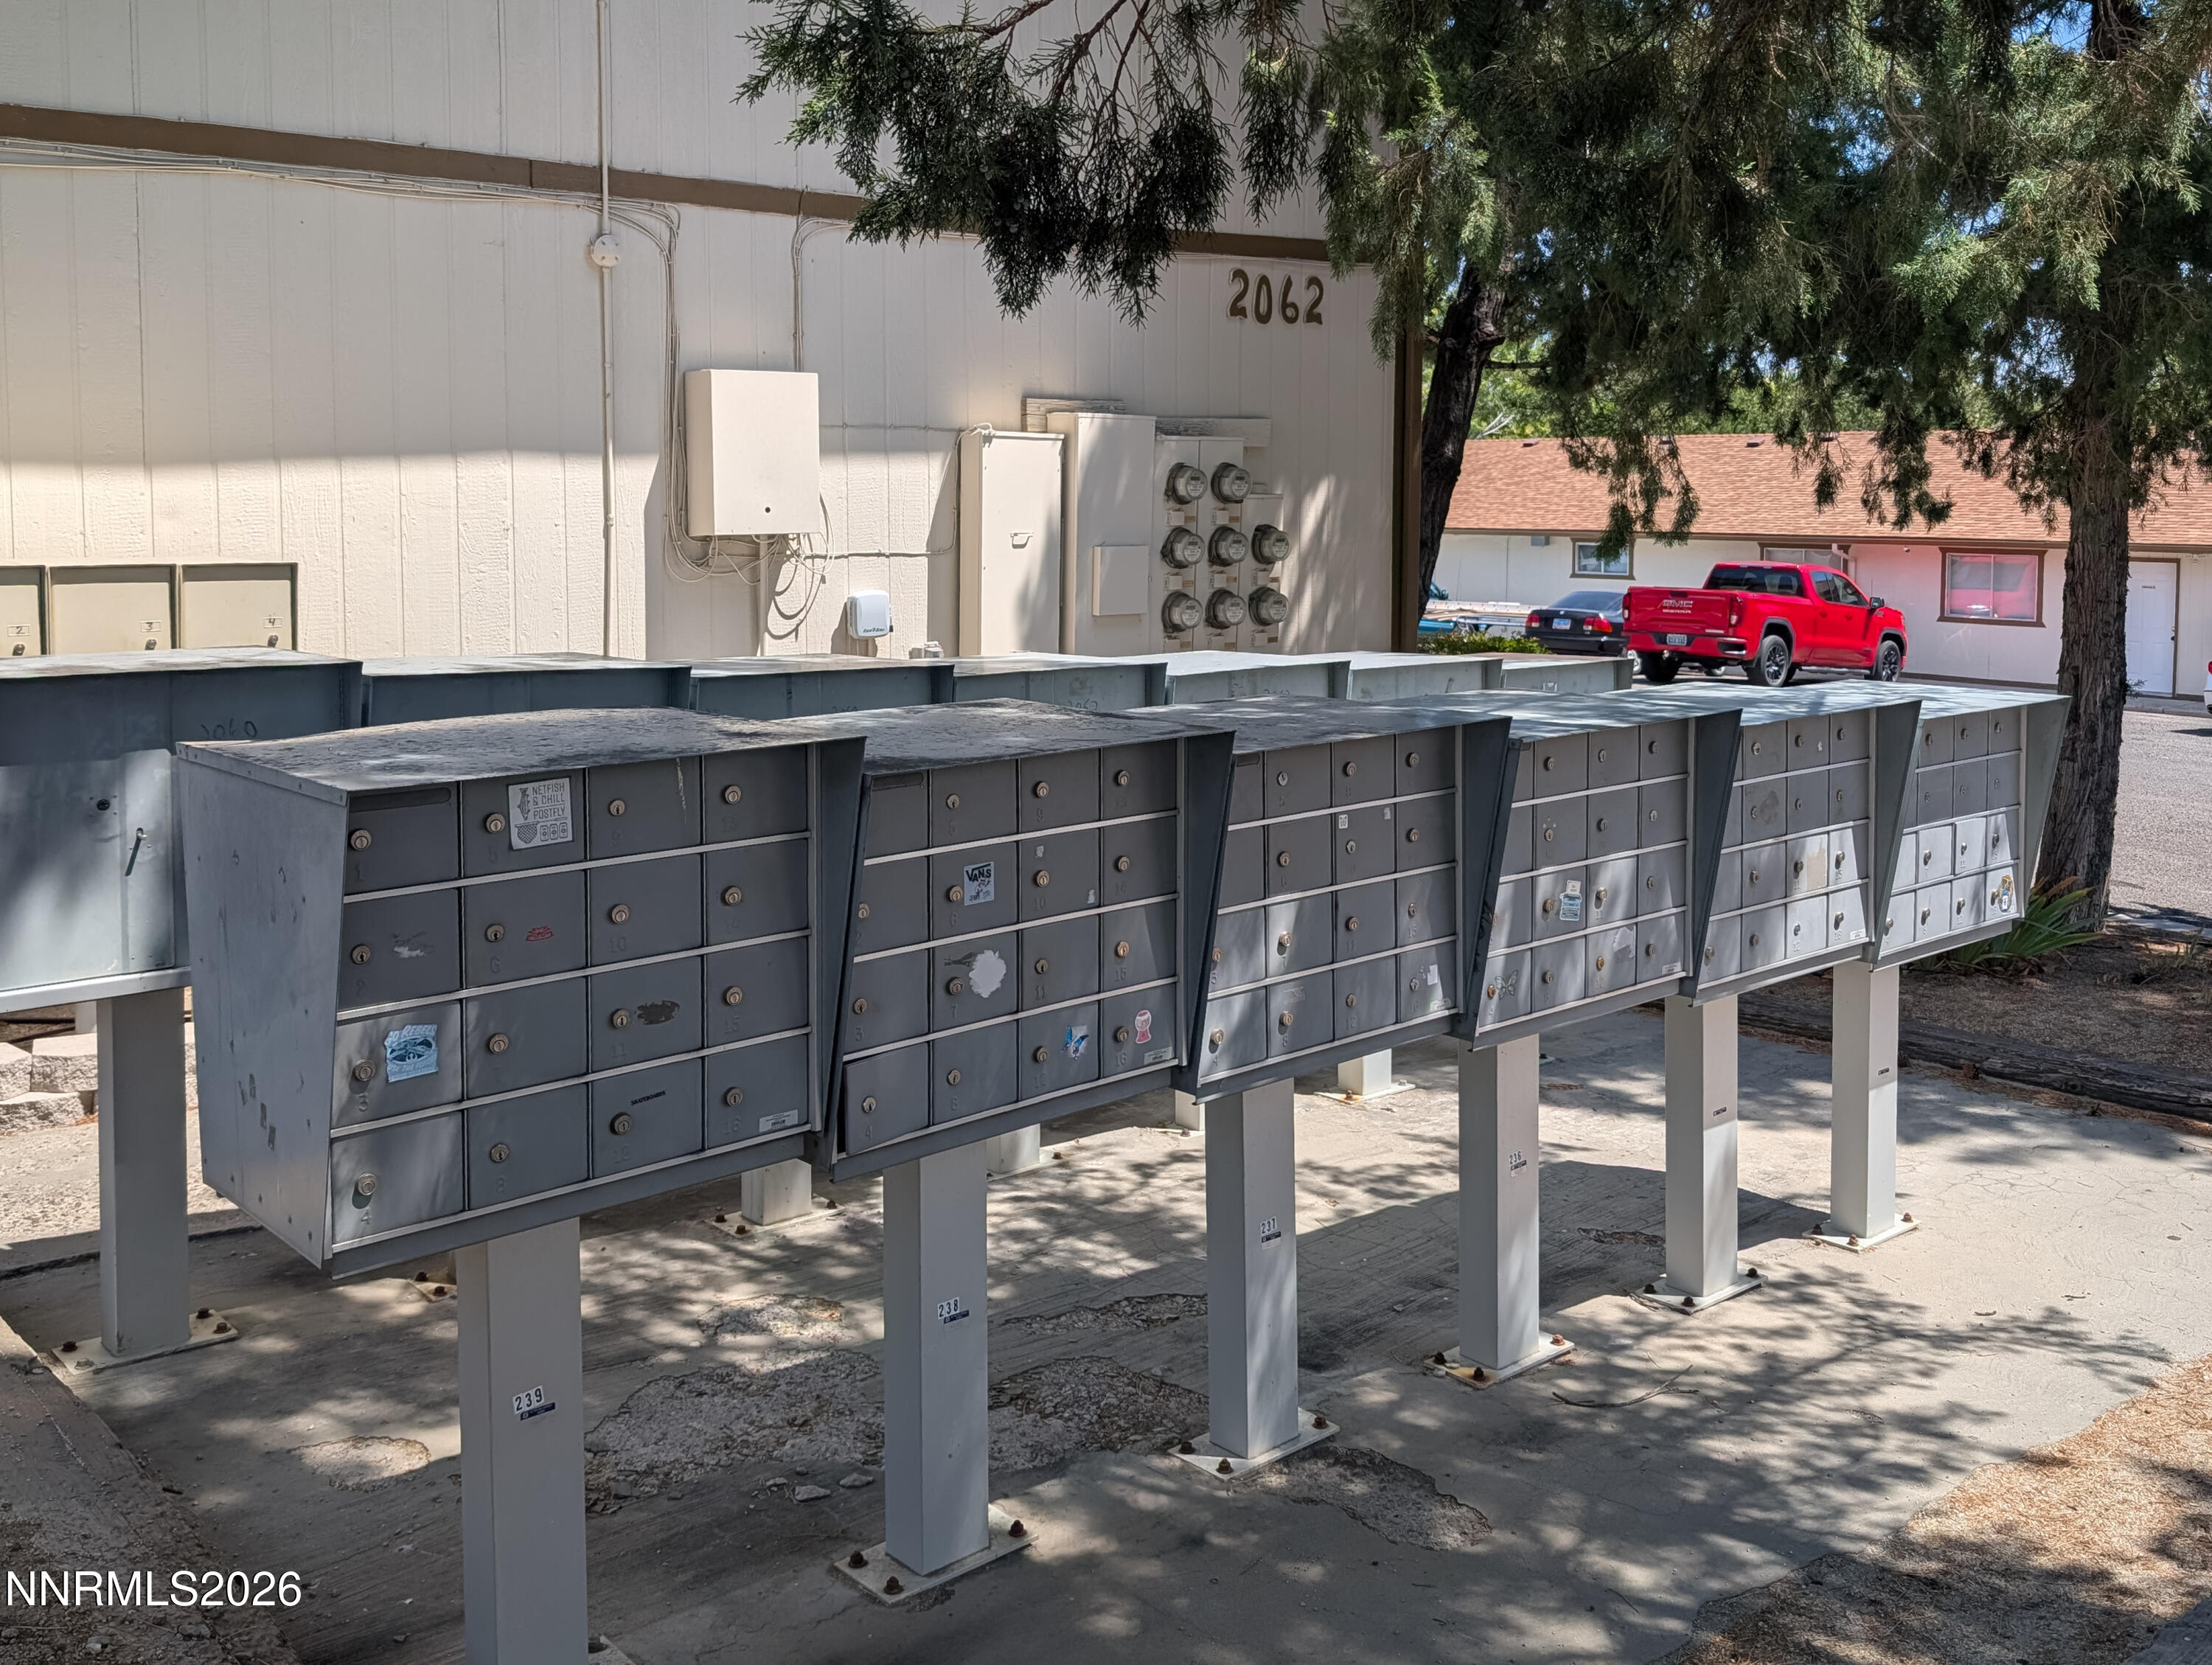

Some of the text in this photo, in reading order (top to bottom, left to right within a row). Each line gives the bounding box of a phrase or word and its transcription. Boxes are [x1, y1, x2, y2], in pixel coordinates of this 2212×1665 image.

[1227, 268, 1324, 324] 2062
[146, 622, 153, 630] 3
[268, 618, 276, 626] 4
[16, 626, 26, 635] 2
[532, 782, 565, 796] NETFISH
[532, 793, 565, 806] & CHILL
[533, 806, 566, 820] POSTFLY
[1037, 808, 1043, 822] 9
[965, 863, 992, 883] VANS
[1033, 897, 1046, 911] 10
[609, 936, 626, 953] 10
[490, 956, 501, 973] 6
[1114, 967, 1127, 982] 15
[950, 1004, 958, 1019] 7
[855, 1026, 863, 1041] 3
[1114, 1052, 1127, 1067] 16
[723, 1116, 741, 1135] 16
[864, 1125, 872, 1139] 4
[1509, 1150, 1521, 1165] 236
[495, 1175, 505, 1193] 8
[361, 1211, 371, 1225] 4
[939, 1299, 959, 1318] 238
[515, 1388, 543, 1411] 239
